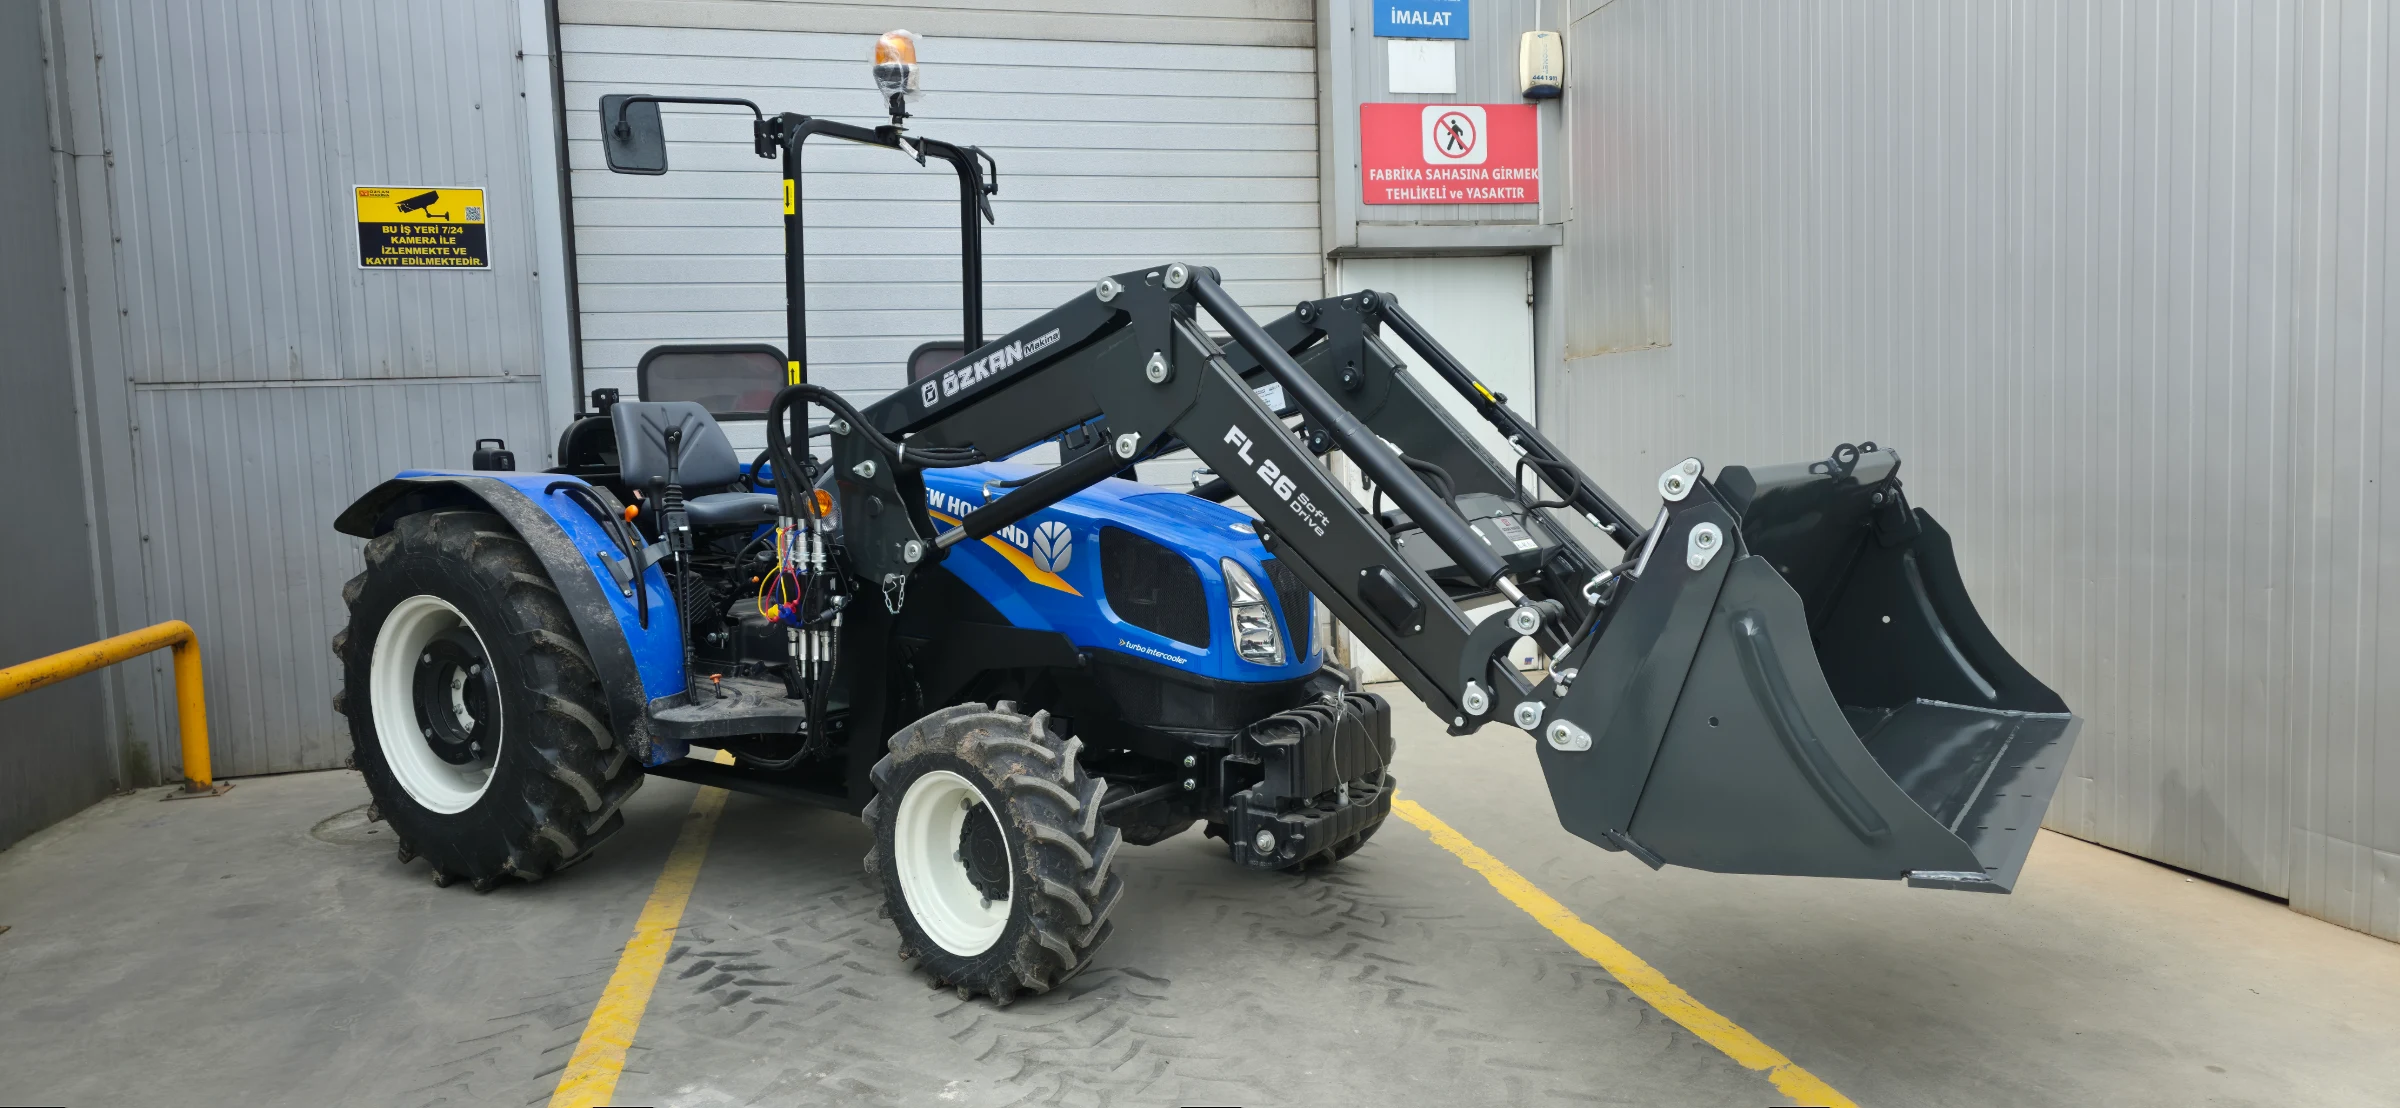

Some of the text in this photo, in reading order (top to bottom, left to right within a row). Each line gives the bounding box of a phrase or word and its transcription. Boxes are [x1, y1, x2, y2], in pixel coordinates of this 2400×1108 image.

[1391, 6, 1452, 26] İMALAT
[1369, 166, 1539, 180] FABRİKA SAHASINA GİRMEK
[1386, 185, 1525, 200] TEHLİKELİ ve YASAKTIR
[382, 224, 463, 235] BU İŞ YERİ 7/24
[381, 245, 467, 255] İZLENMEKTE VE
[390, 235, 456, 245] KAMERA İLE
[365, 256, 483, 266] KAYIT EDİLMEKTEDİR.
[942, 339, 1024, 397] ÖZKAN
[1025, 332, 1059, 353] Makina
[1223, 424, 1297, 501] FL 26
[1289, 500, 1325, 537] Drive
[1297, 492, 1330, 527] Soft
[947, 495, 1029, 549] HOND
[1125, 641, 1188, 664] turbo intercooler
